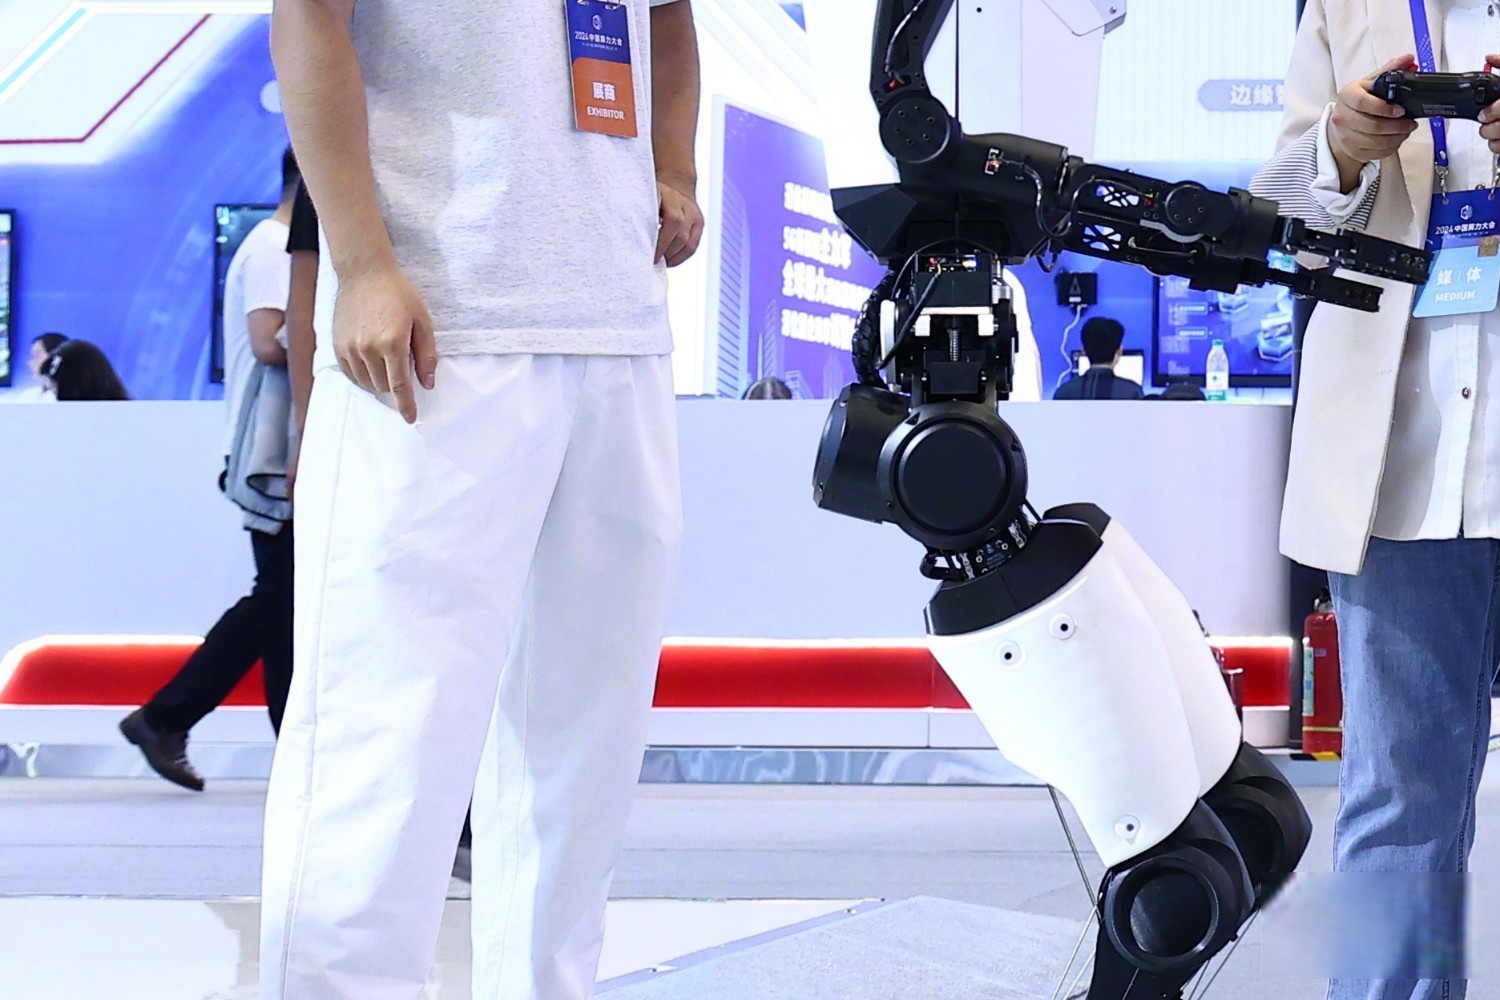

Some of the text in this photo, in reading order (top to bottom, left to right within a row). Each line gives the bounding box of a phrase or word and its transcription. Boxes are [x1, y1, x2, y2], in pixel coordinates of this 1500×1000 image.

[593, 82, 616, 101] 展商
[587, 106, 624, 120] EXHIBITOR
[1435, 290, 1476, 303] MEDIUM
